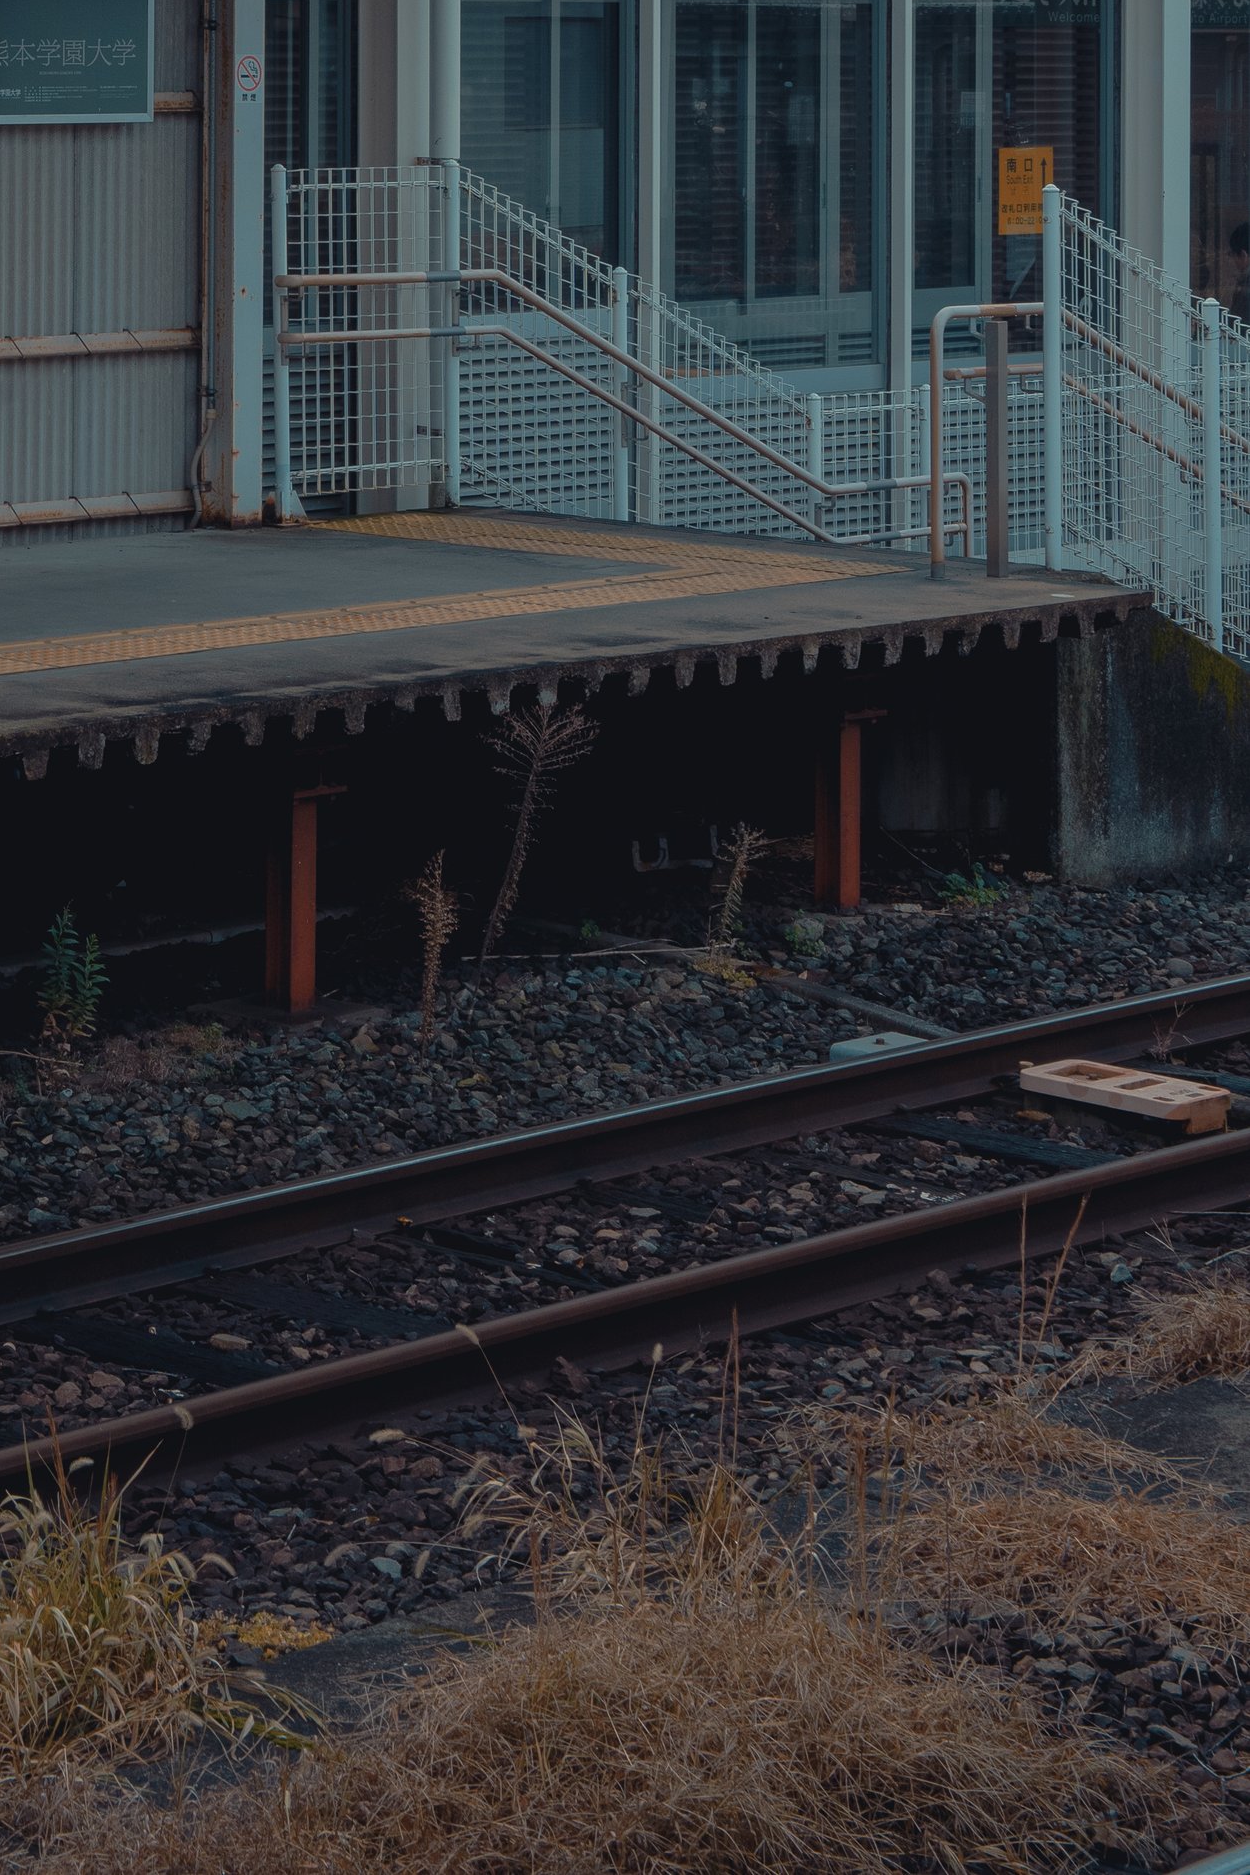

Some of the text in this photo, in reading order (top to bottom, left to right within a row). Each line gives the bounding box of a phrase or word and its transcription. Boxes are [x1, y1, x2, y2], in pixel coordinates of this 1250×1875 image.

[1048, 11, 1100, 23] Welcome
[1209, 12, 1248, 25] Airport
[1006, 157, 1033, 173] 南口
[1006, 174, 1034, 185] South Exit
